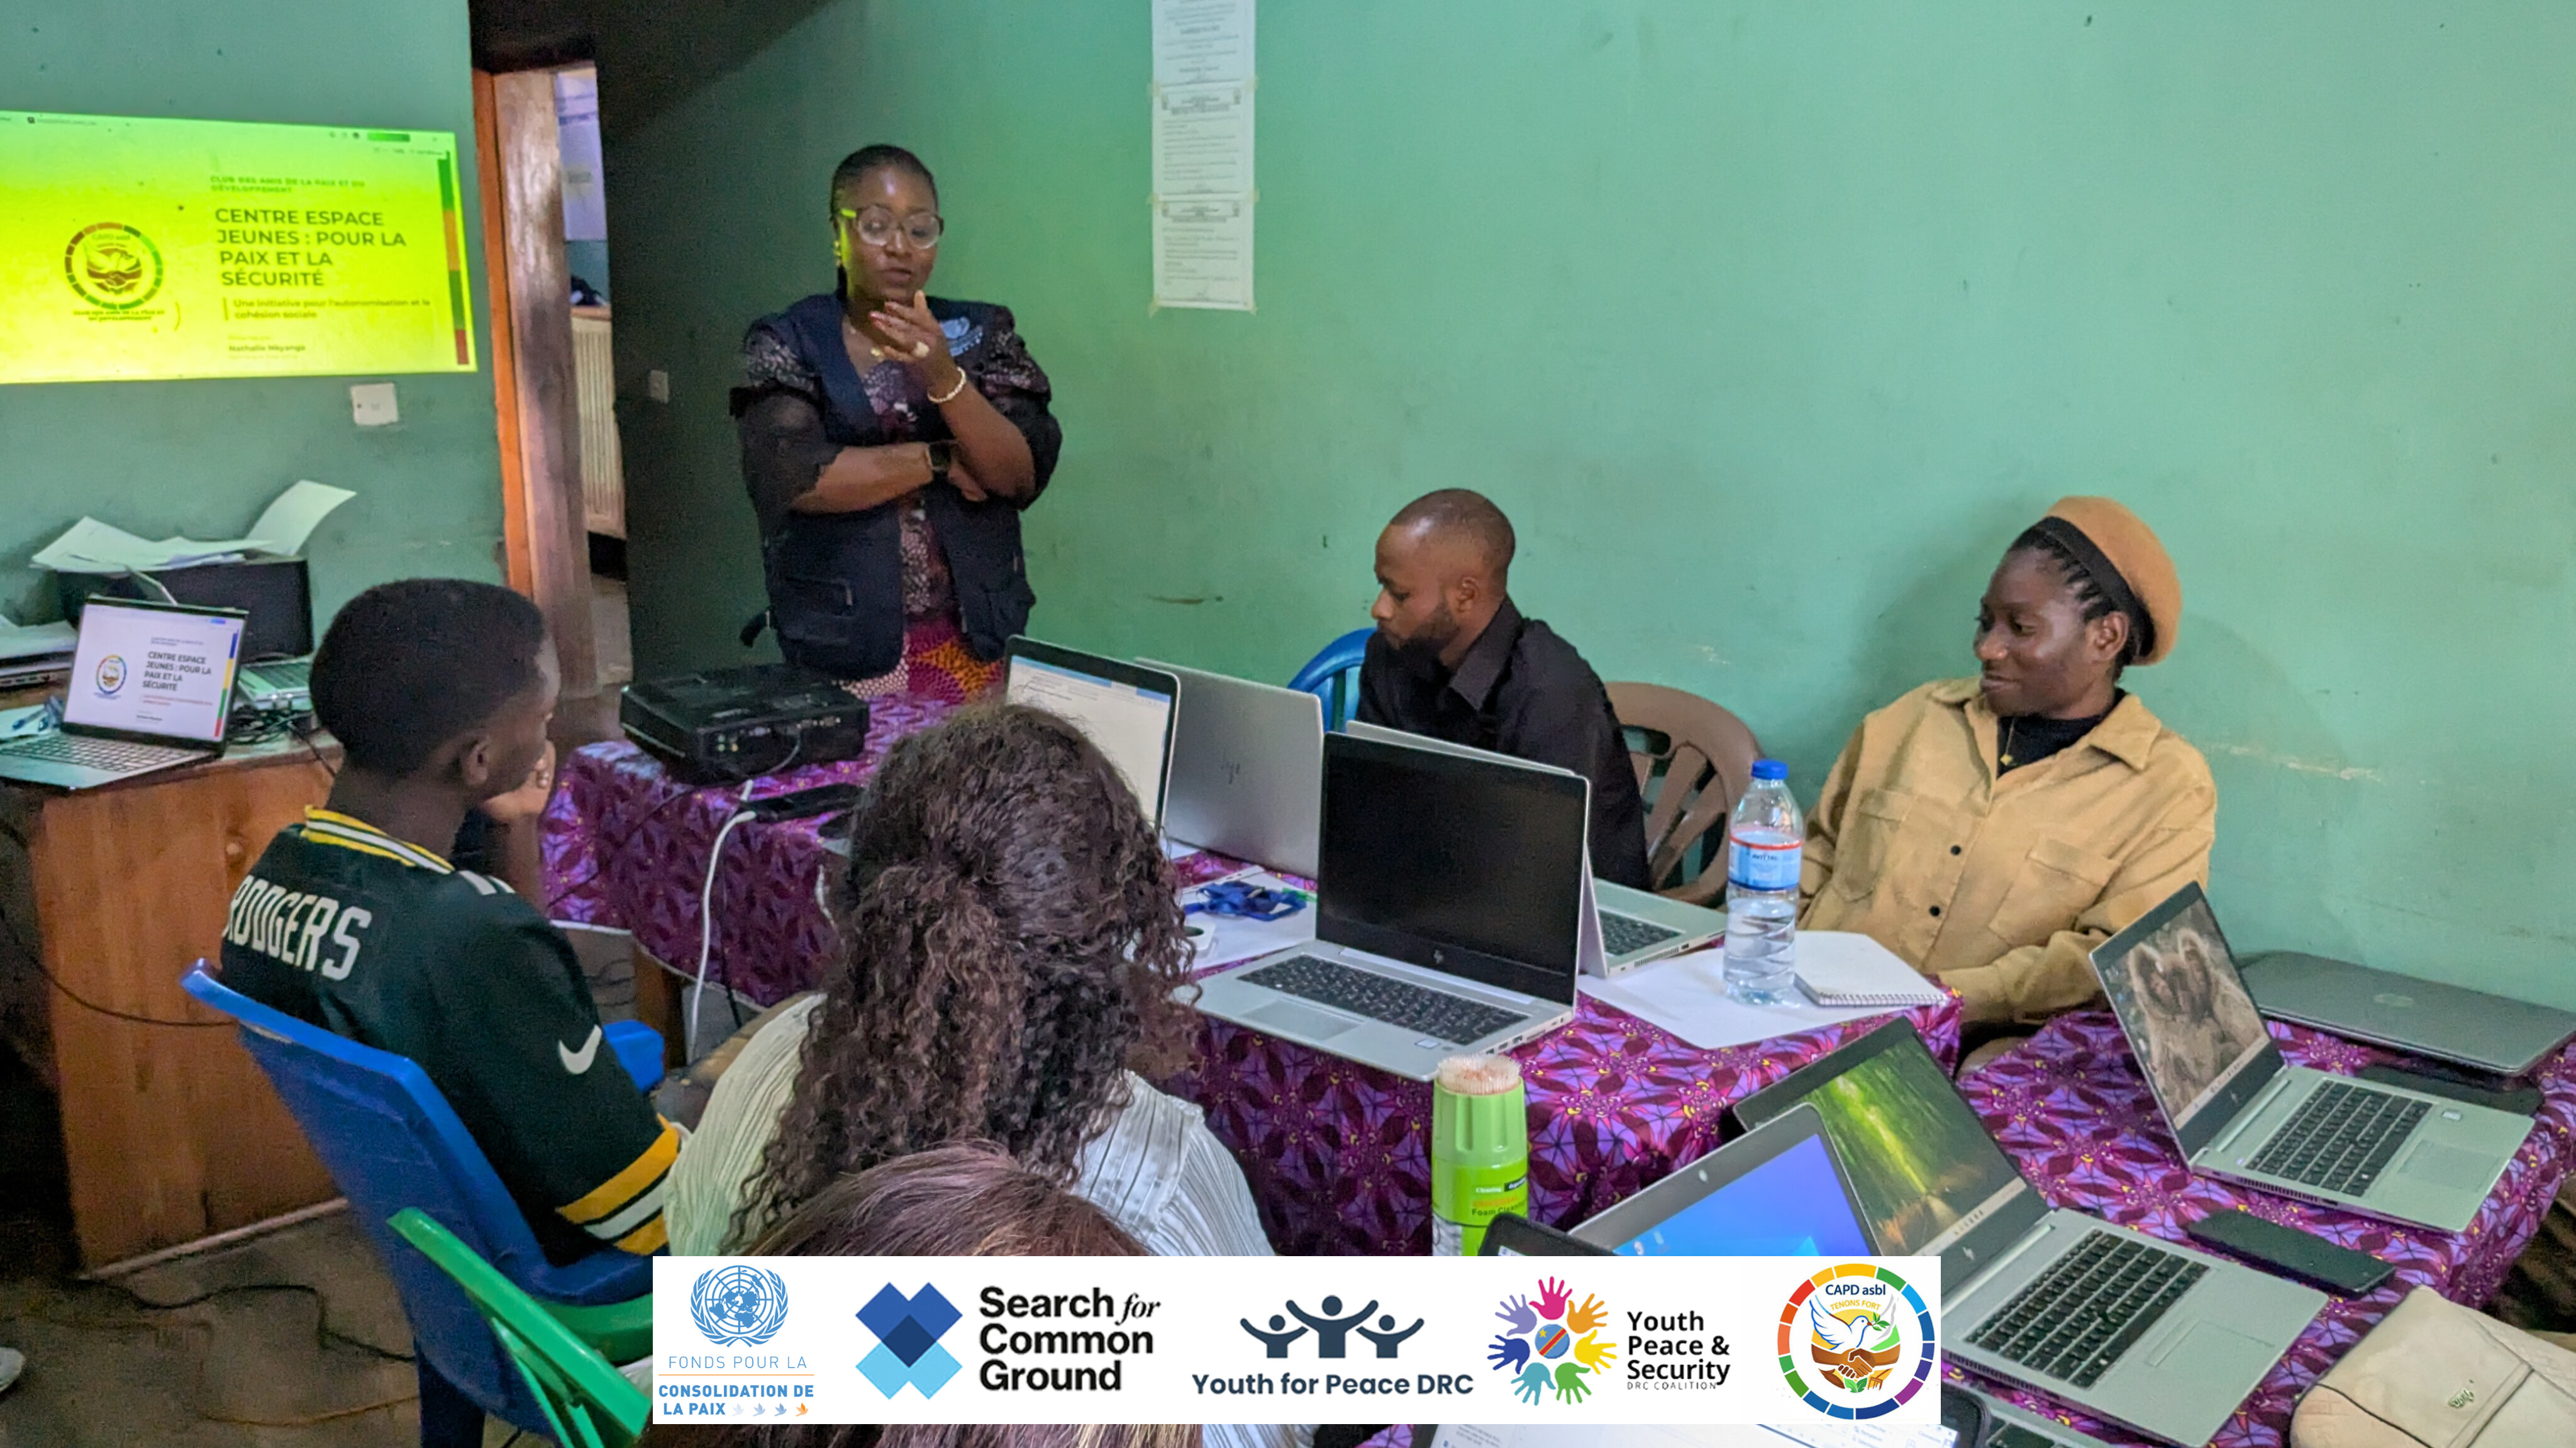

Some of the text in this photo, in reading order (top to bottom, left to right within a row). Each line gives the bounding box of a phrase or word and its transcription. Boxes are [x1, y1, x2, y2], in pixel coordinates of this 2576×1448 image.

[215, 208, 384, 226] CENTRE ESPACE
[217, 230, 300, 245] JEUNES
[317, 231, 375, 246] POUR
[381, 232, 407, 247] LA
[220, 250, 333, 266] PAIX ET LA
[221, 268, 325, 286] SÉCURITÉ
[234, 299, 253, 308] Une
[257, 299, 301, 308] initiative
[303, 300, 326, 309] pour
[235, 309, 318, 319] cohésion sociale
[148, 651, 206, 664] CENTRE ESPACE
[144, 670, 162, 679] PAIX
[146, 660, 174, 671] JEUNES
[179, 664, 201, 673] POUR
[201, 667, 211, 675] LA
[222, 874, 372, 981] RODGERS
[1472, 1208, 1496, 1216] Foam
